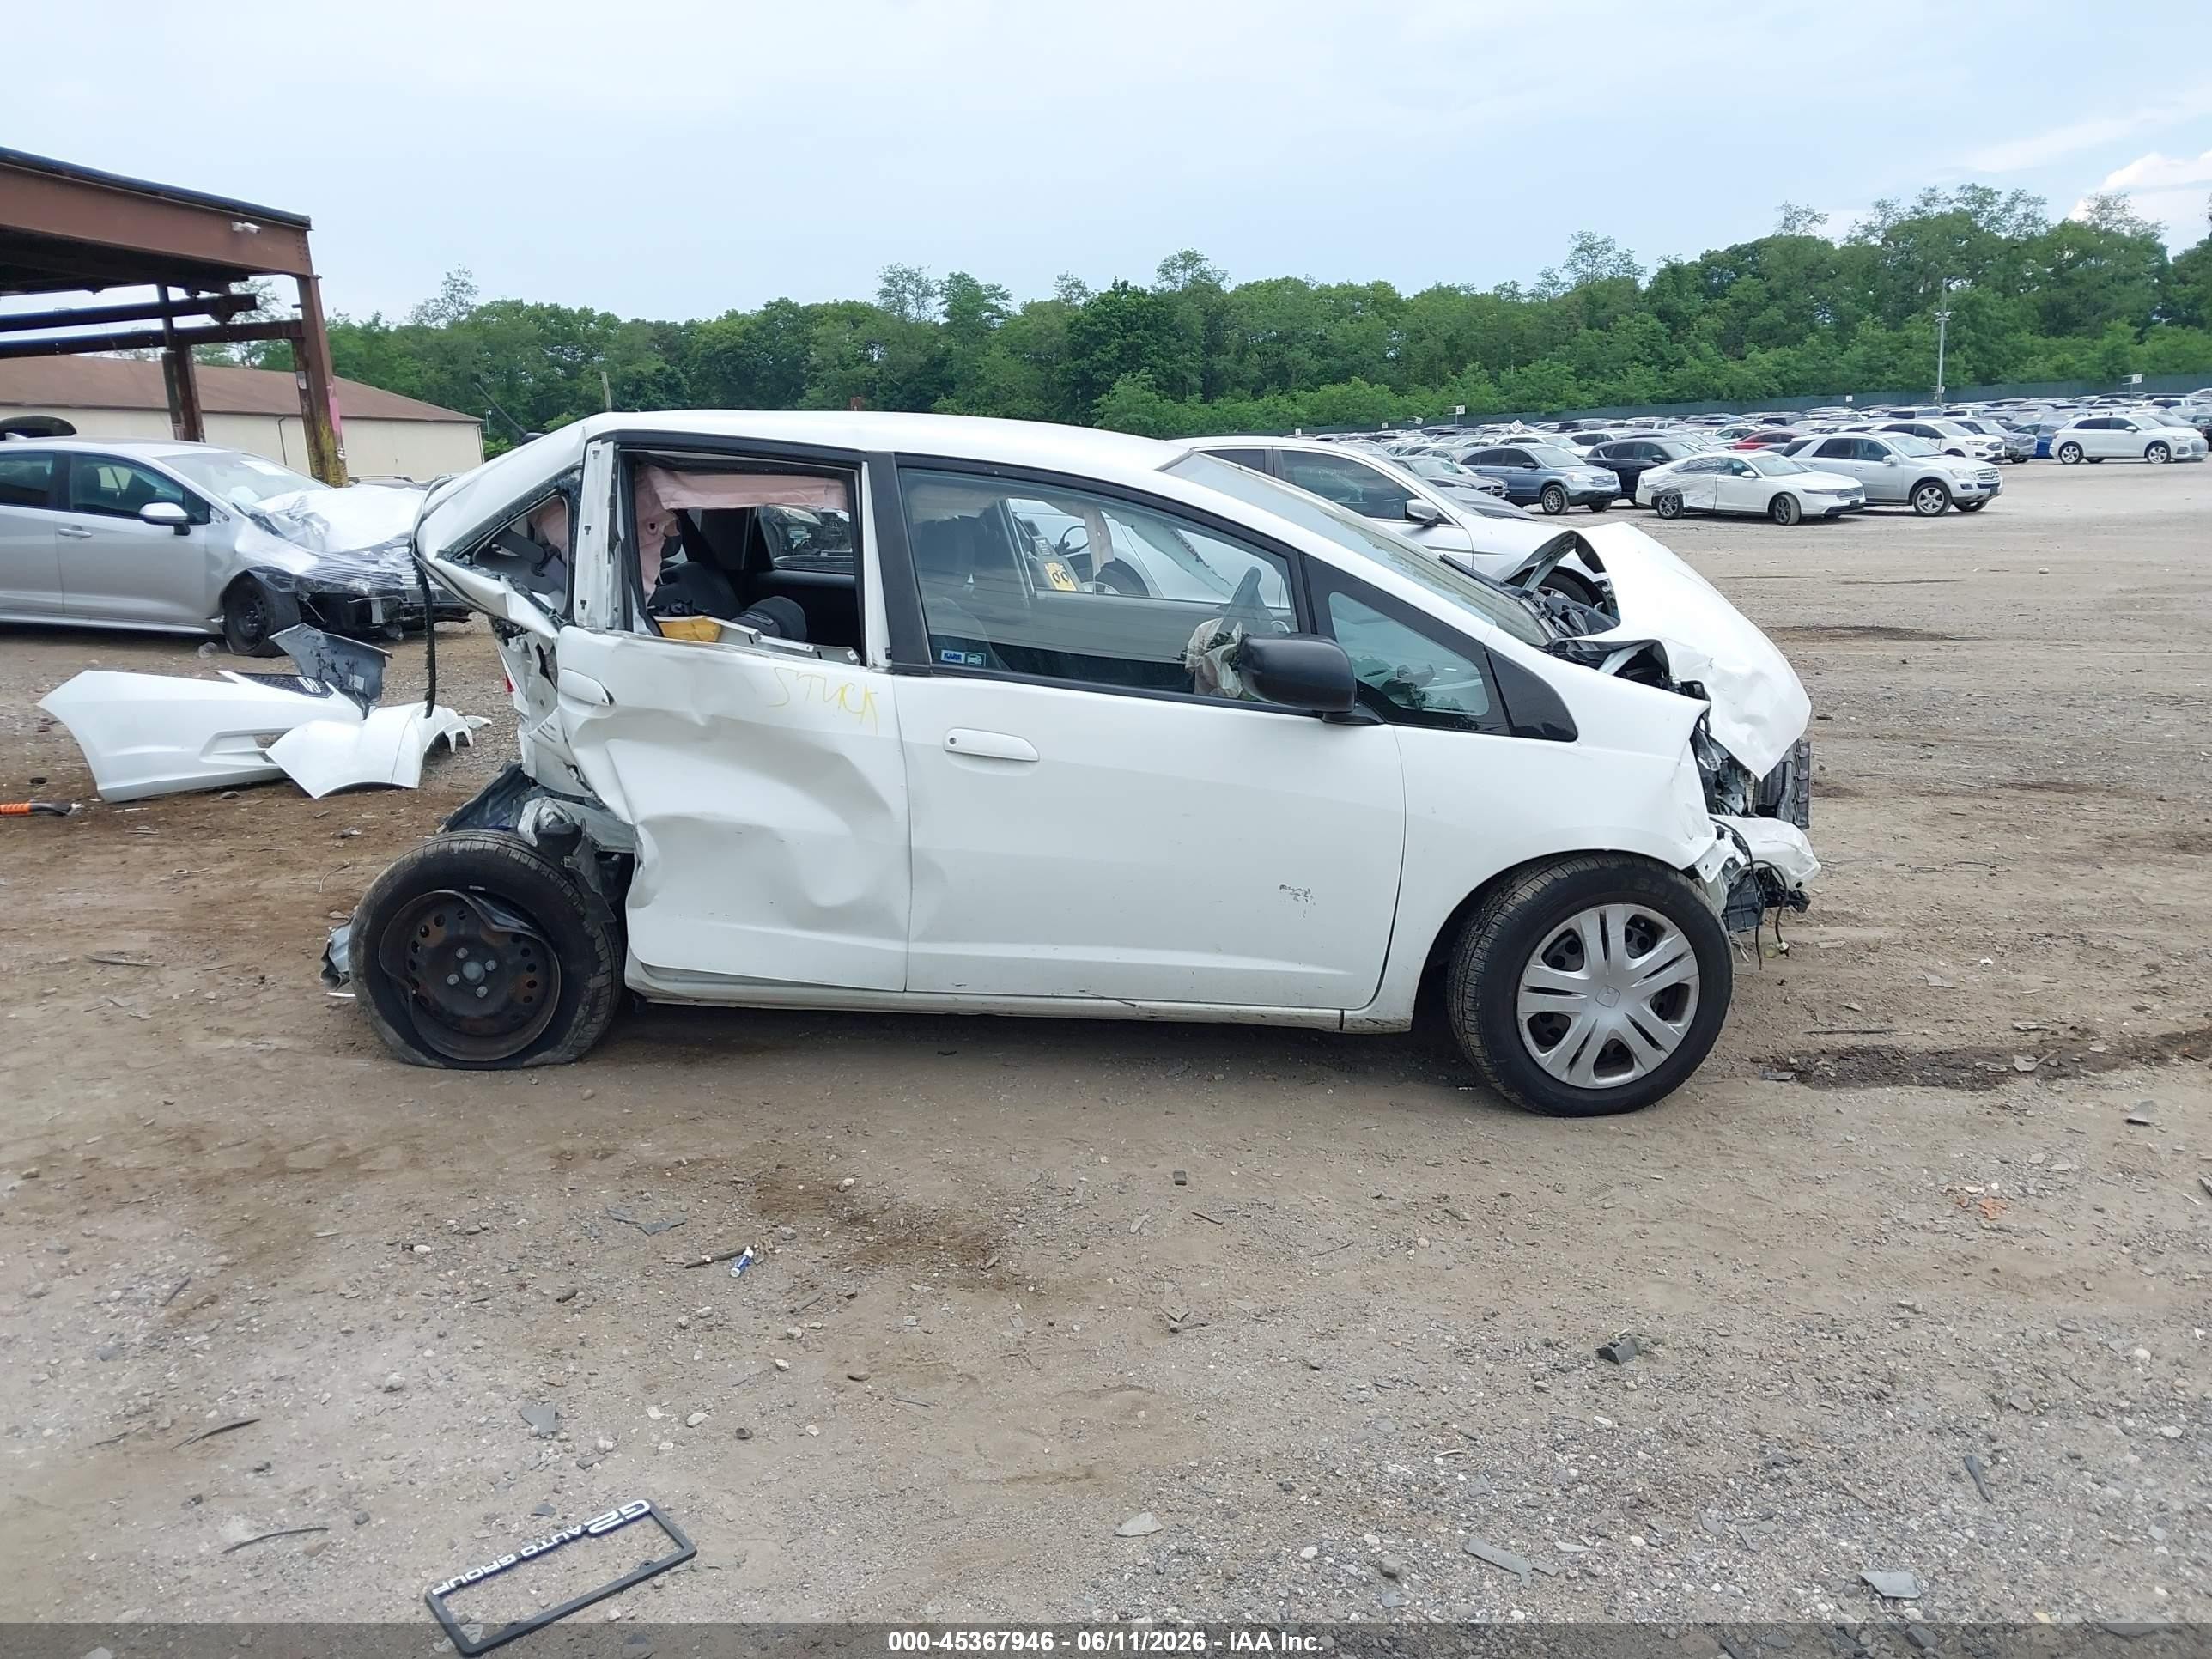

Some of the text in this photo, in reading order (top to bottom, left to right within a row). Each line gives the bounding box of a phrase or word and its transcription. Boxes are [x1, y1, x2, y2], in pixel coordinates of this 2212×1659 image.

[766, 666, 878, 736] STUCK
[431, 1498, 651, 1595] G2 AUTO GROUP
